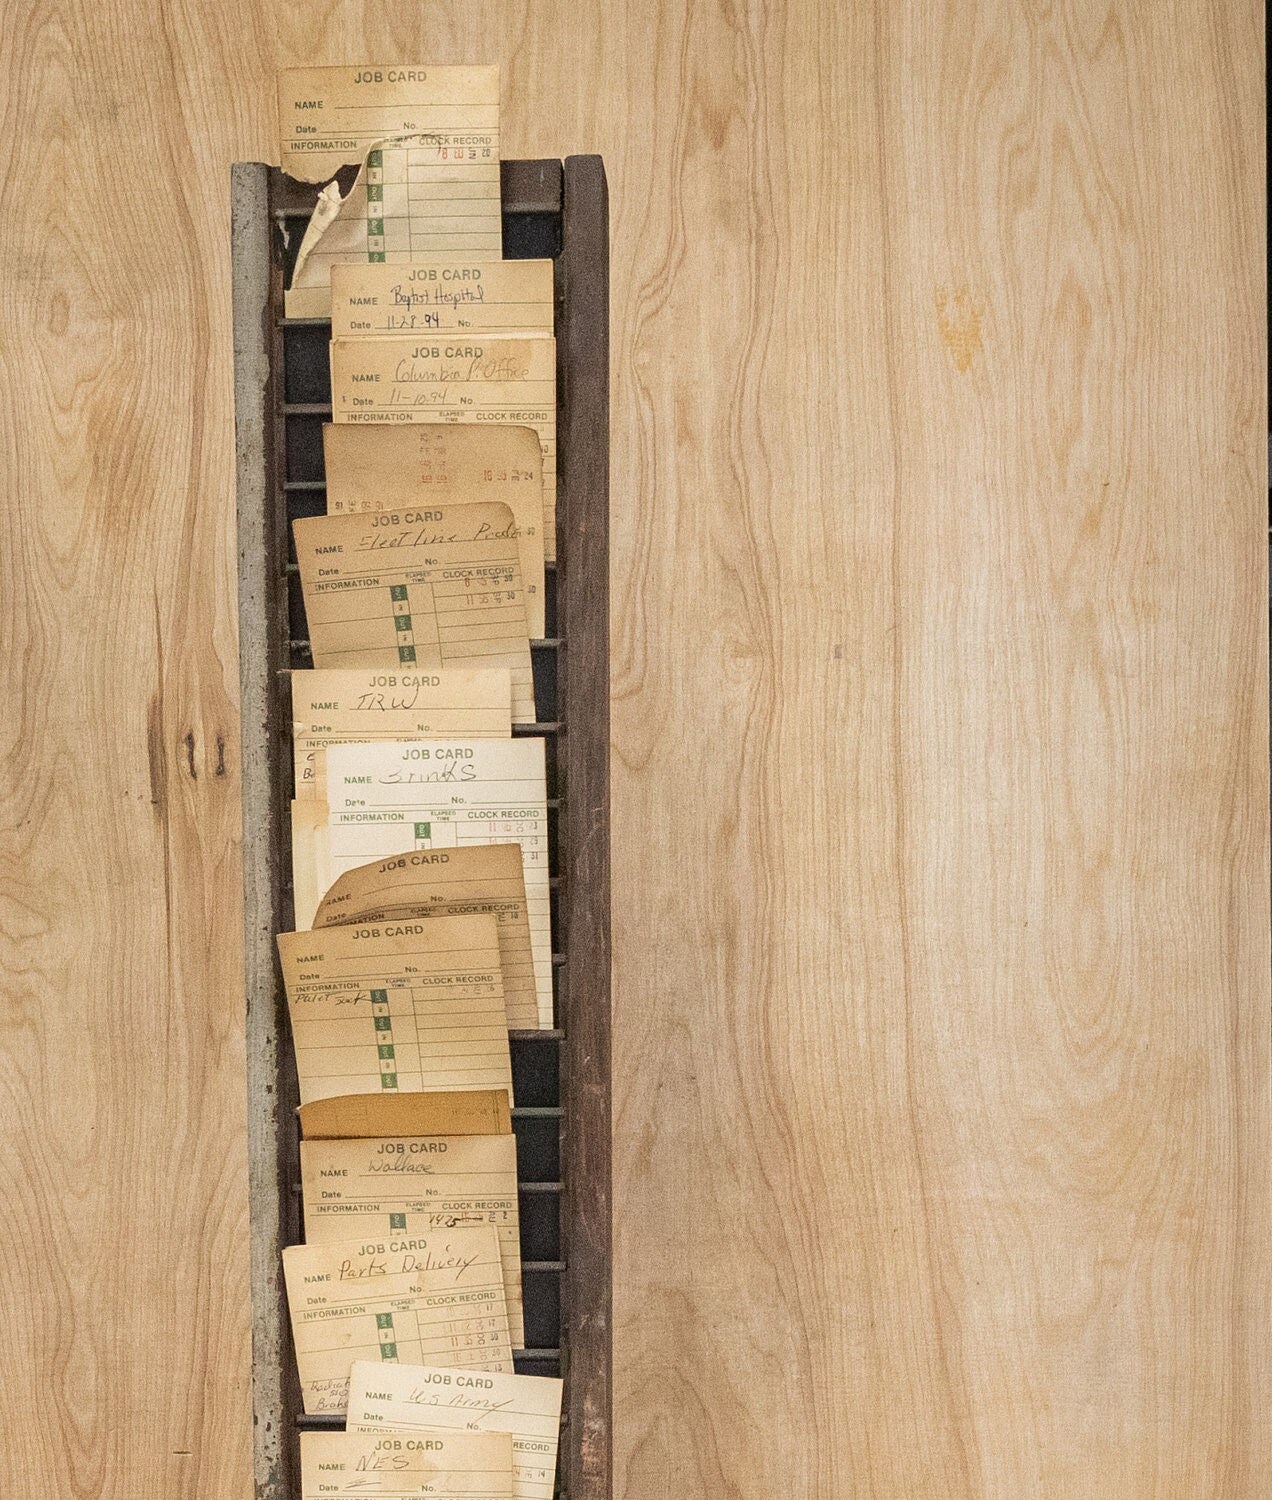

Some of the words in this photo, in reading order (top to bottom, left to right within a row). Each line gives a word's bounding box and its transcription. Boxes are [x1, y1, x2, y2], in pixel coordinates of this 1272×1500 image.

[355, 72, 383, 83] JOB
[388, 71, 427, 82] CARD
[295, 101, 323, 109] NAME
[291, 140, 357, 150] INFORMATION
[409, 270, 436, 281] JOB
[442, 269, 481, 280] CARD
[350, 297, 378, 305] NAME
[412, 348, 439, 359] JOB
[445, 347, 483, 358] CARD
[352, 374, 380, 382] NAME
[347, 414, 413, 422] INFORMATION
[476, 413, 506, 421] CLOCK
[372, 515, 399, 527] JOB
[405, 511, 443, 523] CARD
[315, 545, 343, 555] NAME
[369, 677, 396, 687] JOB
[402, 676, 440, 686] CARD
[357, 678, 419, 711] TRW
[402, 750, 430, 760] JOB
[435, 749, 473, 759] CARD
[344, 776, 372, 784] NAME
[340, 813, 404, 822] INFORMATION
[468, 811, 498, 819] CLOCK
[501, 810, 539, 818] RECORD
[379, 859, 406, 873] JOB
[411, 854, 449, 865] CARD
[352, 929, 380, 939] JOB
[385, 926, 423, 937] CARD
[296, 955, 324, 963] NAME
[296, 983, 360, 992] INFORMATION
[377, 1144, 404, 1154] JOB
[409, 1143, 447, 1153] CARD
[317, 1204, 380, 1212] INFORMATION
[359, 1245, 385, 1256] JOB
[390, 1240, 427, 1253] CARD
[338, 1259, 387, 1280] Parts
[401, 1245, 479, 1280] Delivery
[304, 1275, 331, 1283] NAME
[304, 1307, 365, 1320] INFORMATION
[425, 1374, 451, 1385] JOB
[457, 1377, 493, 1388] CARD
[366, 1392, 392, 1400] NAME
[375, 1441, 401, 1450] JOB
[406, 1441, 443, 1450] CARD
[356, 1452, 409, 1471] NES
